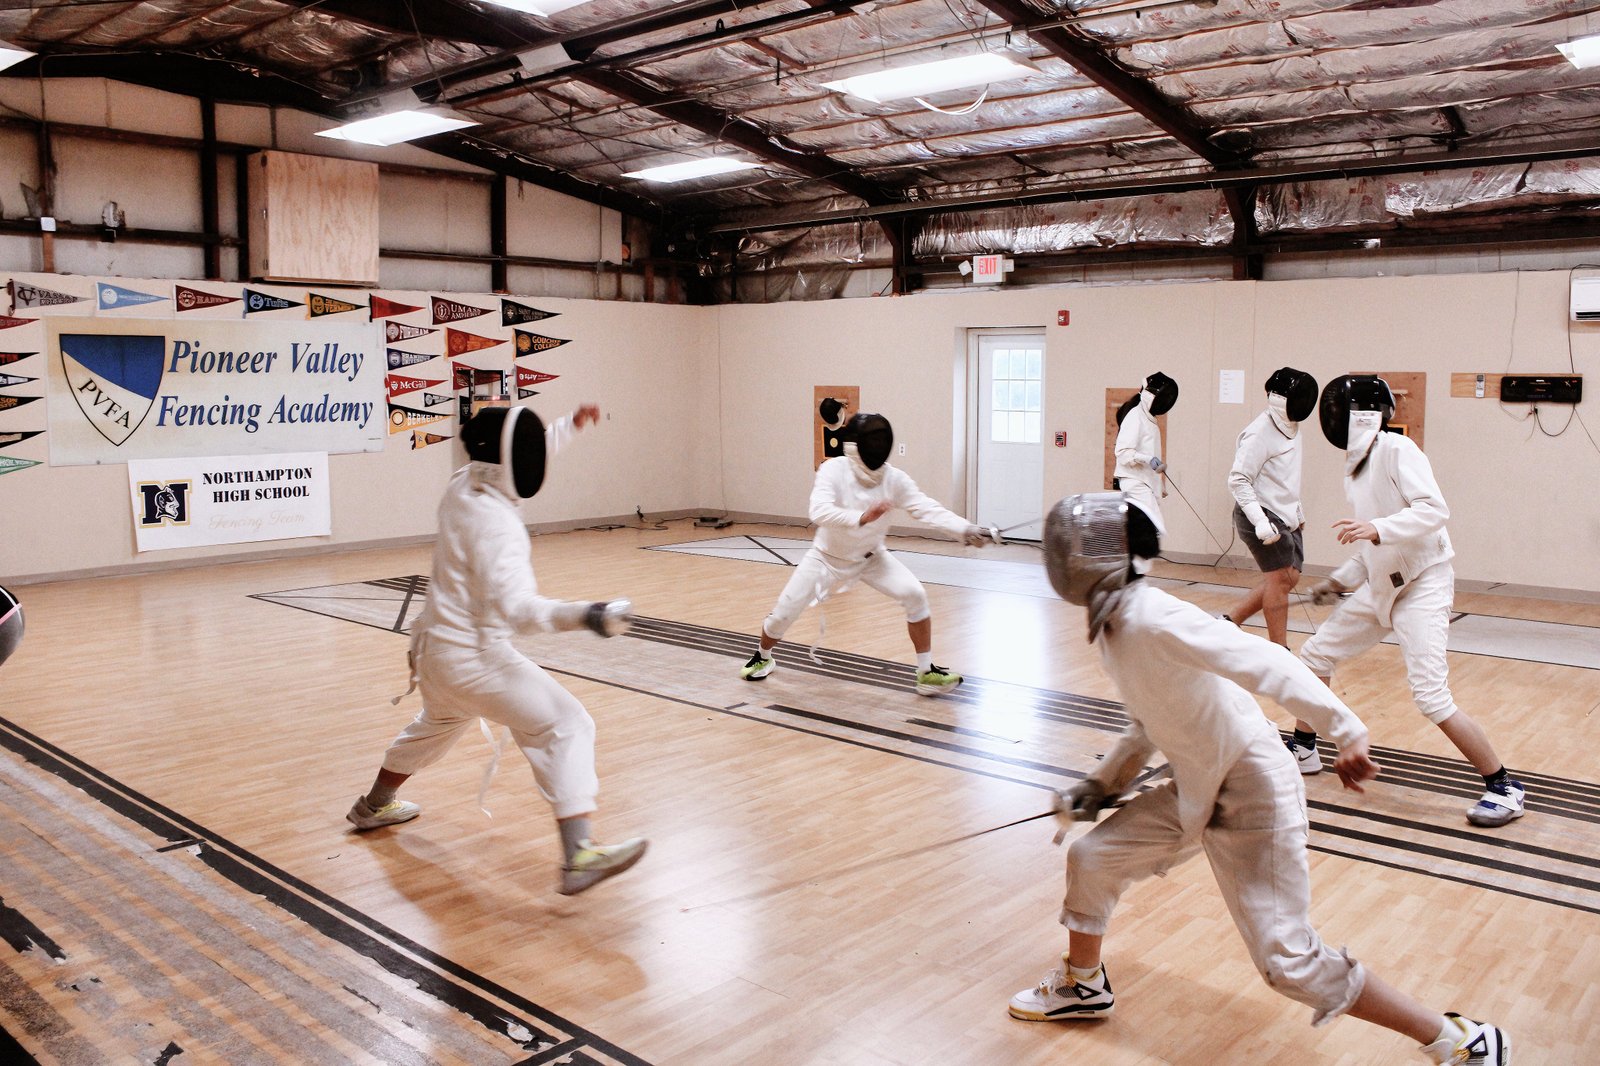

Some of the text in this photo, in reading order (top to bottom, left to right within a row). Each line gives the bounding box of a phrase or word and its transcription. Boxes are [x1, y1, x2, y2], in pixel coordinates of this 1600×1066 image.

[978, 257, 997, 275] EXIT
[264, 297, 289, 308] Tufts
[399, 325, 429, 340] FHAM
[167, 340, 364, 382] Pioneer Valley
[400, 380, 427, 389] McGill
[77, 377, 130, 429] PVFA
[155, 393, 374, 433] Fencing Academy
[203, 467, 313, 485] NORTHAMPTON
[213, 485, 310, 503] HIGH SCHOOL
[208, 513, 263, 534] Fencing
